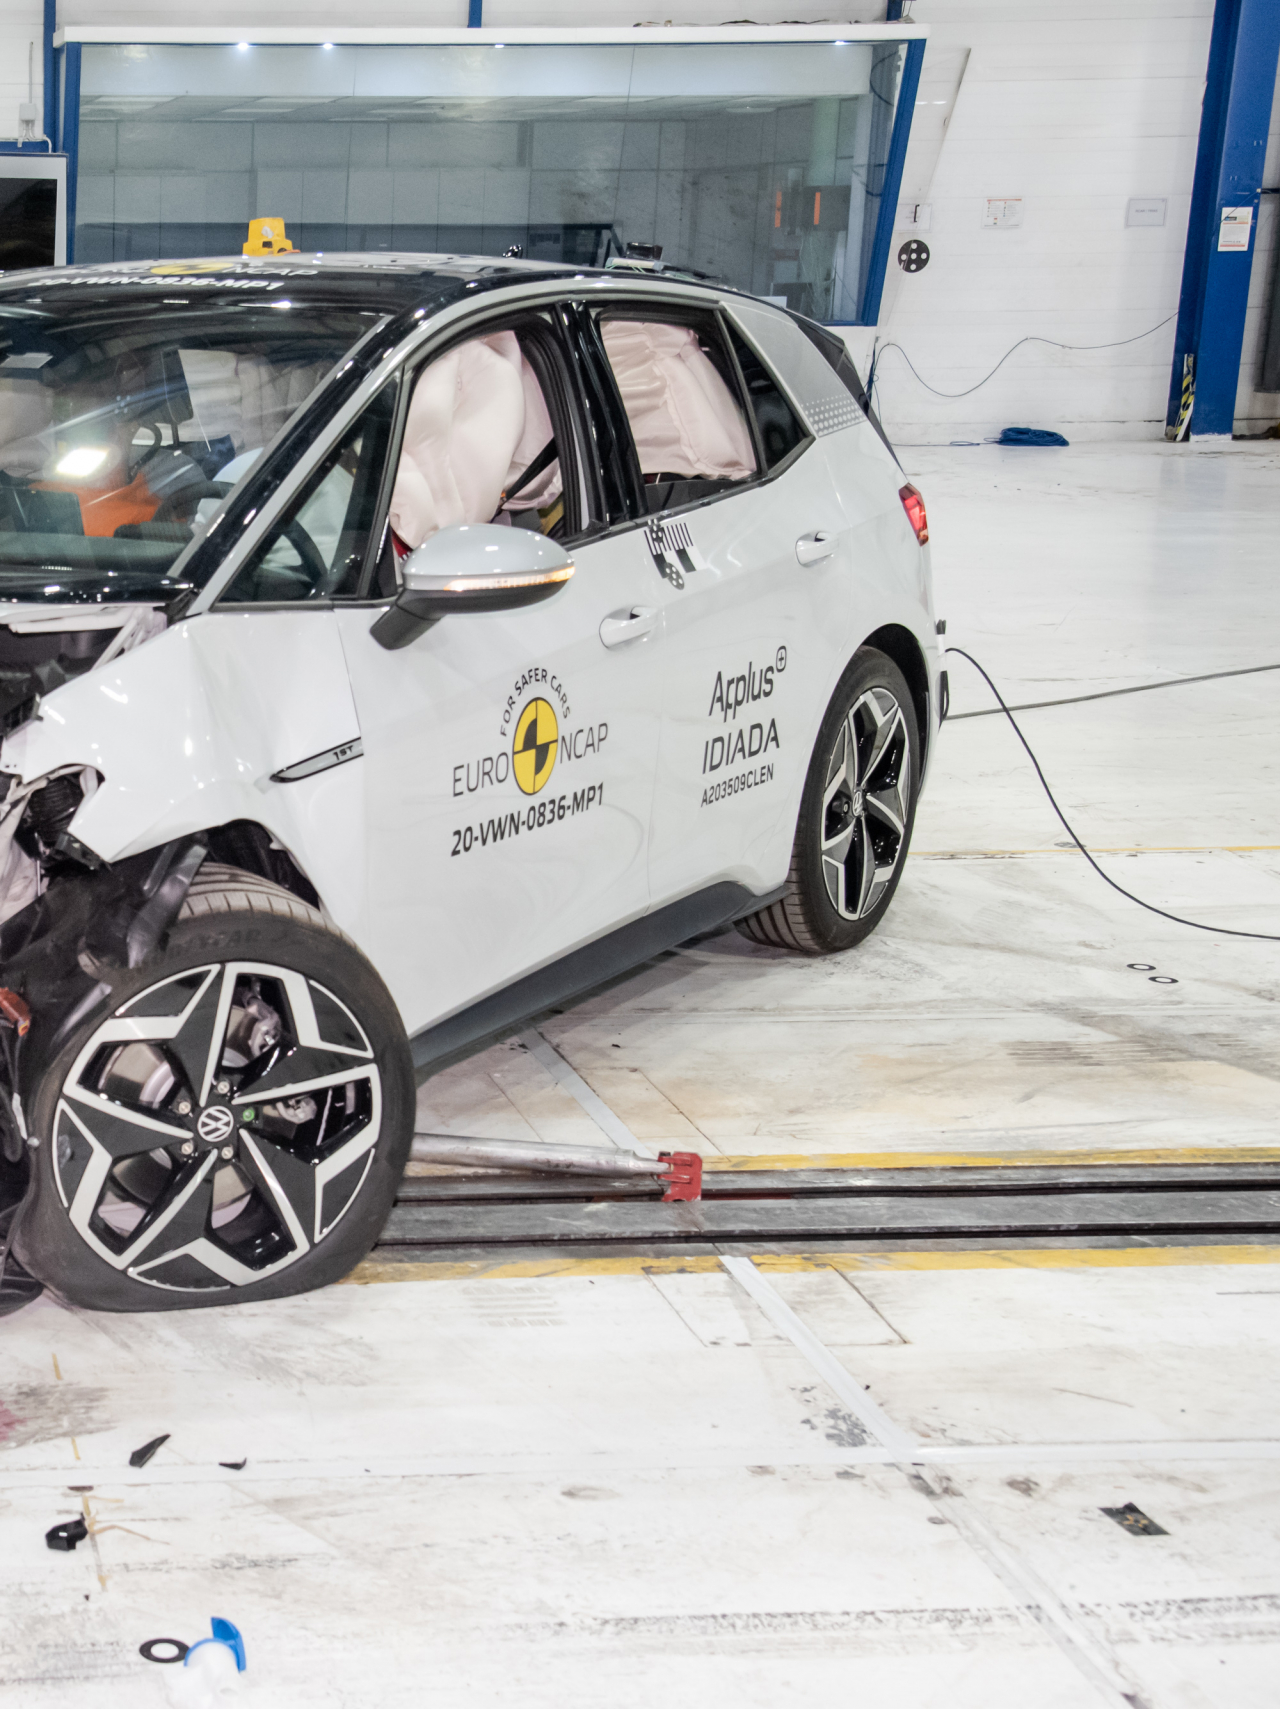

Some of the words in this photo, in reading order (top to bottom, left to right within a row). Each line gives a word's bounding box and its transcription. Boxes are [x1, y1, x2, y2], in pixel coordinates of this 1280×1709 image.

[27, 275, 285, 291] 20-VWN-0836-MP1
[221, 264, 319, 276] NCAP
[500, 695, 516, 737] FOR
[514, 667, 547, 696] SAFER
[550, 675, 570, 719] CARS
[332, 744, 354, 761] 1ST
[453, 751, 509, 797] EURO
[560, 722, 608, 764] NCAP
[702, 718, 780, 775] IDIADA
[701, 762, 775, 808] A203509CLEN
[451, 782, 604, 857] 20-VWN-0836-MP1
